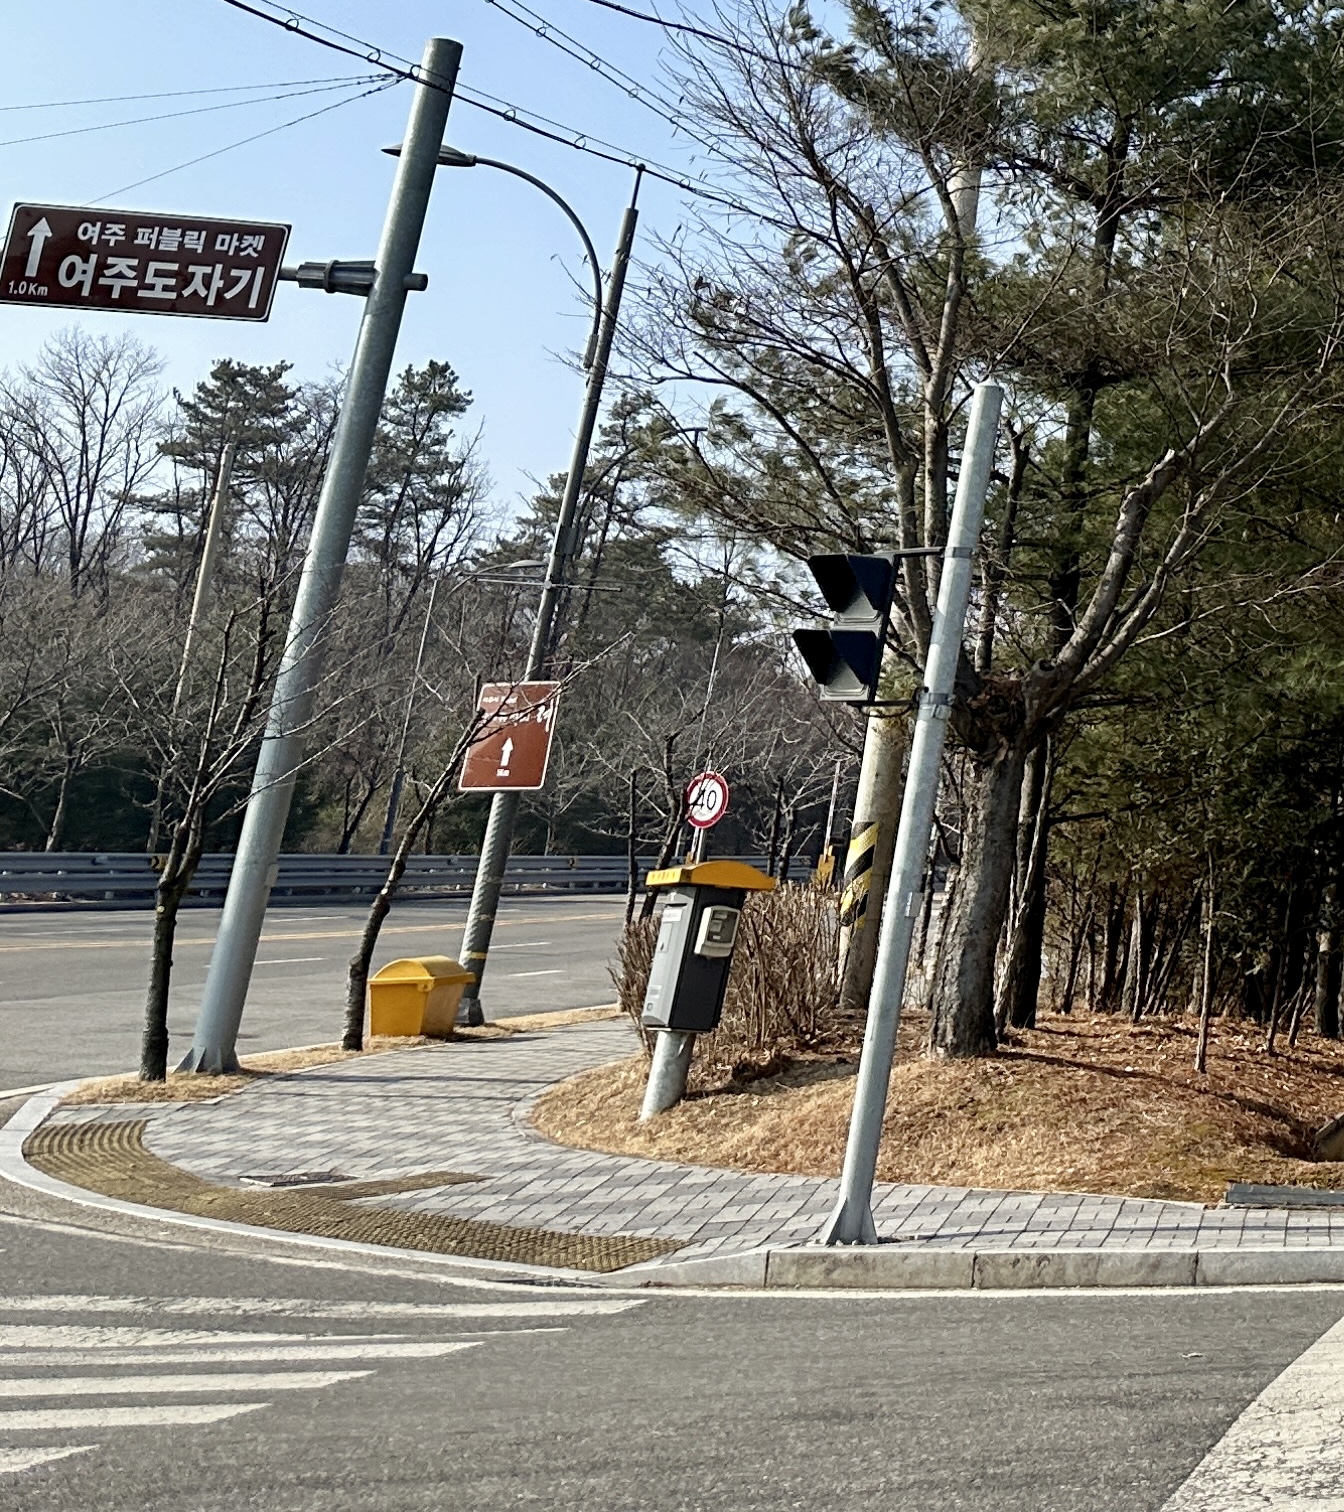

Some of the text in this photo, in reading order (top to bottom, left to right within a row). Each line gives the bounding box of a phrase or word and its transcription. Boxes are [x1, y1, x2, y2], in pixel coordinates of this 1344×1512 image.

[78, 221, 265, 258] 여주 퍼블릭 마켓
[58, 253, 265, 309] 여주도자기
[691, 788, 717, 811] 40
